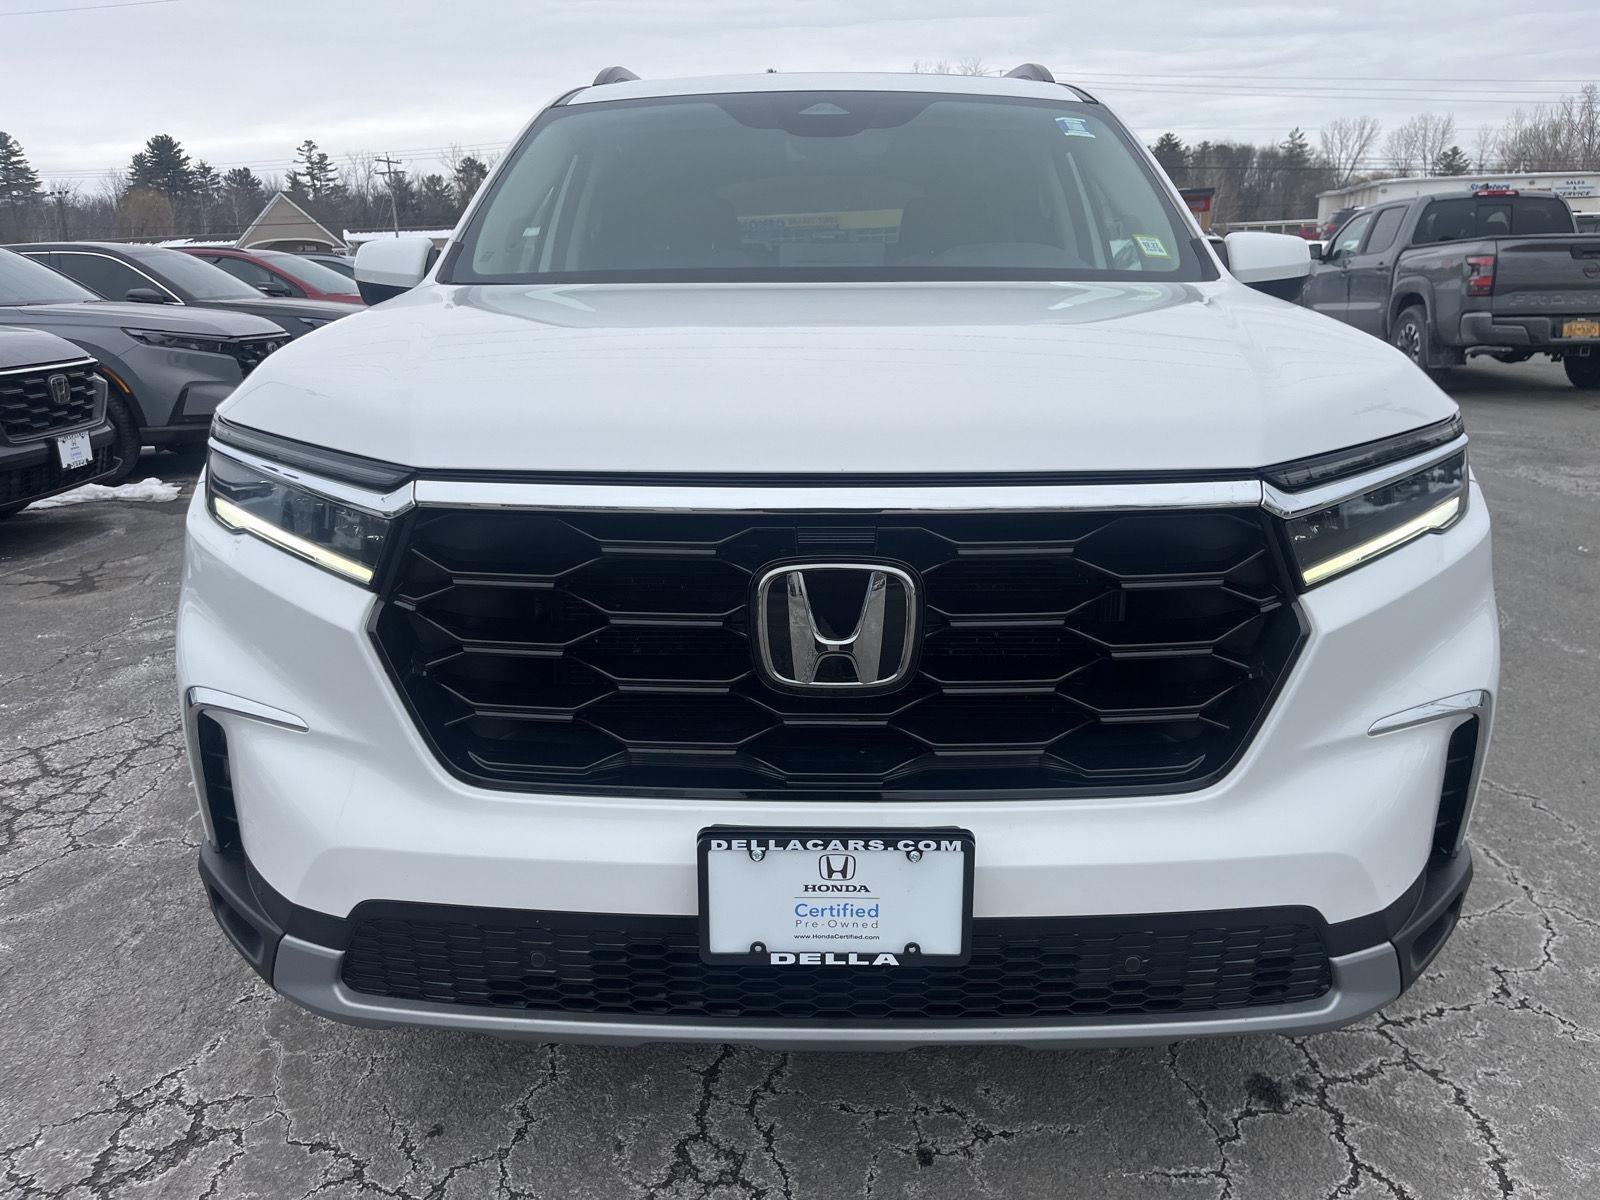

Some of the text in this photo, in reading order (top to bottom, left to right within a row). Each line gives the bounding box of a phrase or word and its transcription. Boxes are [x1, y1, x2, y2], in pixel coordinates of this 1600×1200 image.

[709, 839, 963, 851] DELLACARS.COM
[803, 884, 871, 893] HONDA
[794, 903, 880, 918] Certified
[795, 919, 879, 929] Pre-Owned
[793, 933, 881, 941] www.HondaCertified.com
[769, 952, 900, 966] DELLA
